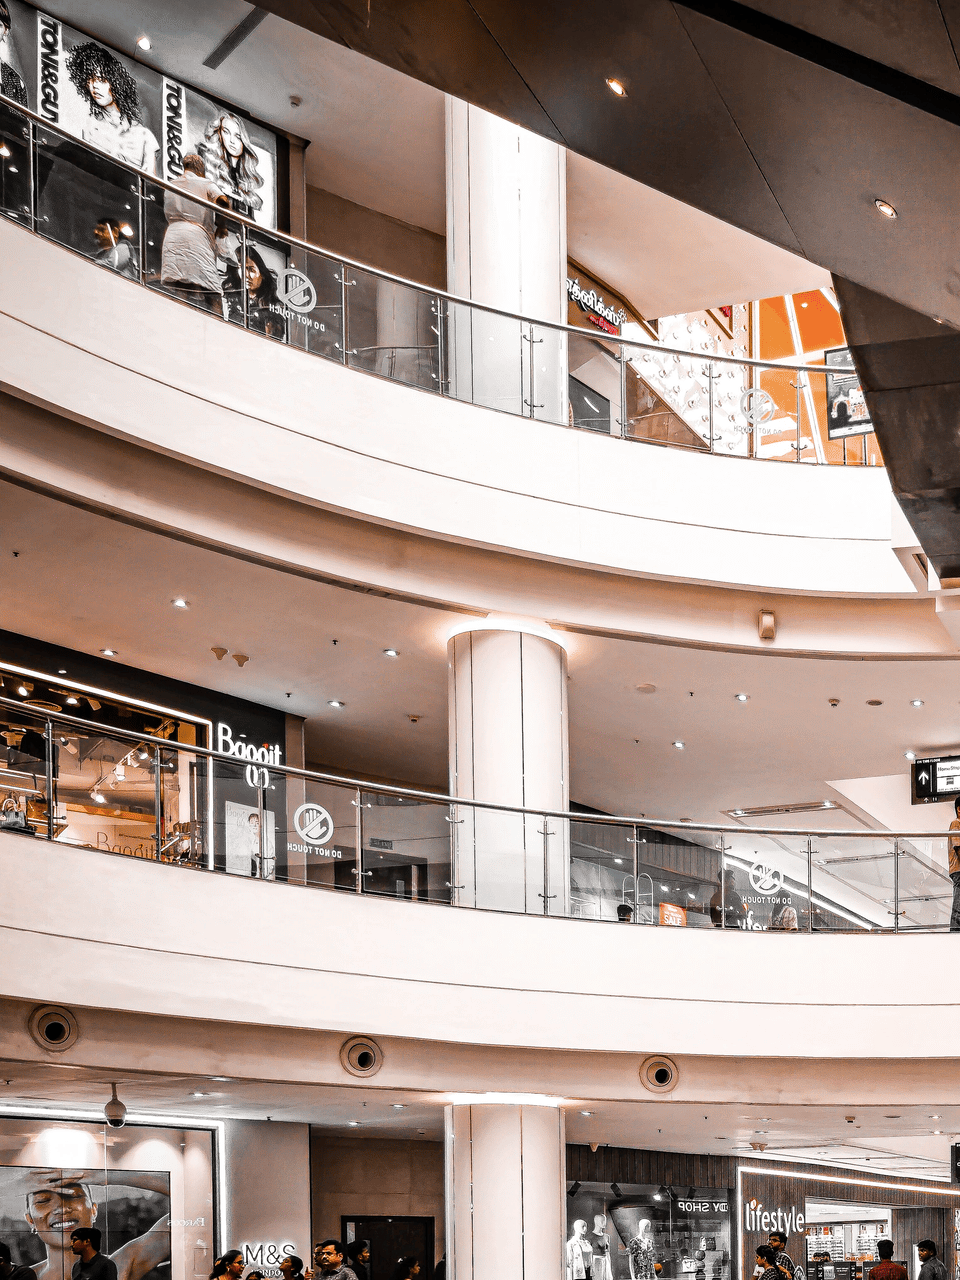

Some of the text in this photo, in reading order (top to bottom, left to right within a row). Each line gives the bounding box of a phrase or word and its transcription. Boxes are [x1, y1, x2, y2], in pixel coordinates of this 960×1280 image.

[166, 83, 183, 181] TONI&GU
[664, 914, 682, 926] SALE
[746, 1199, 805, 1238] lifestyle
